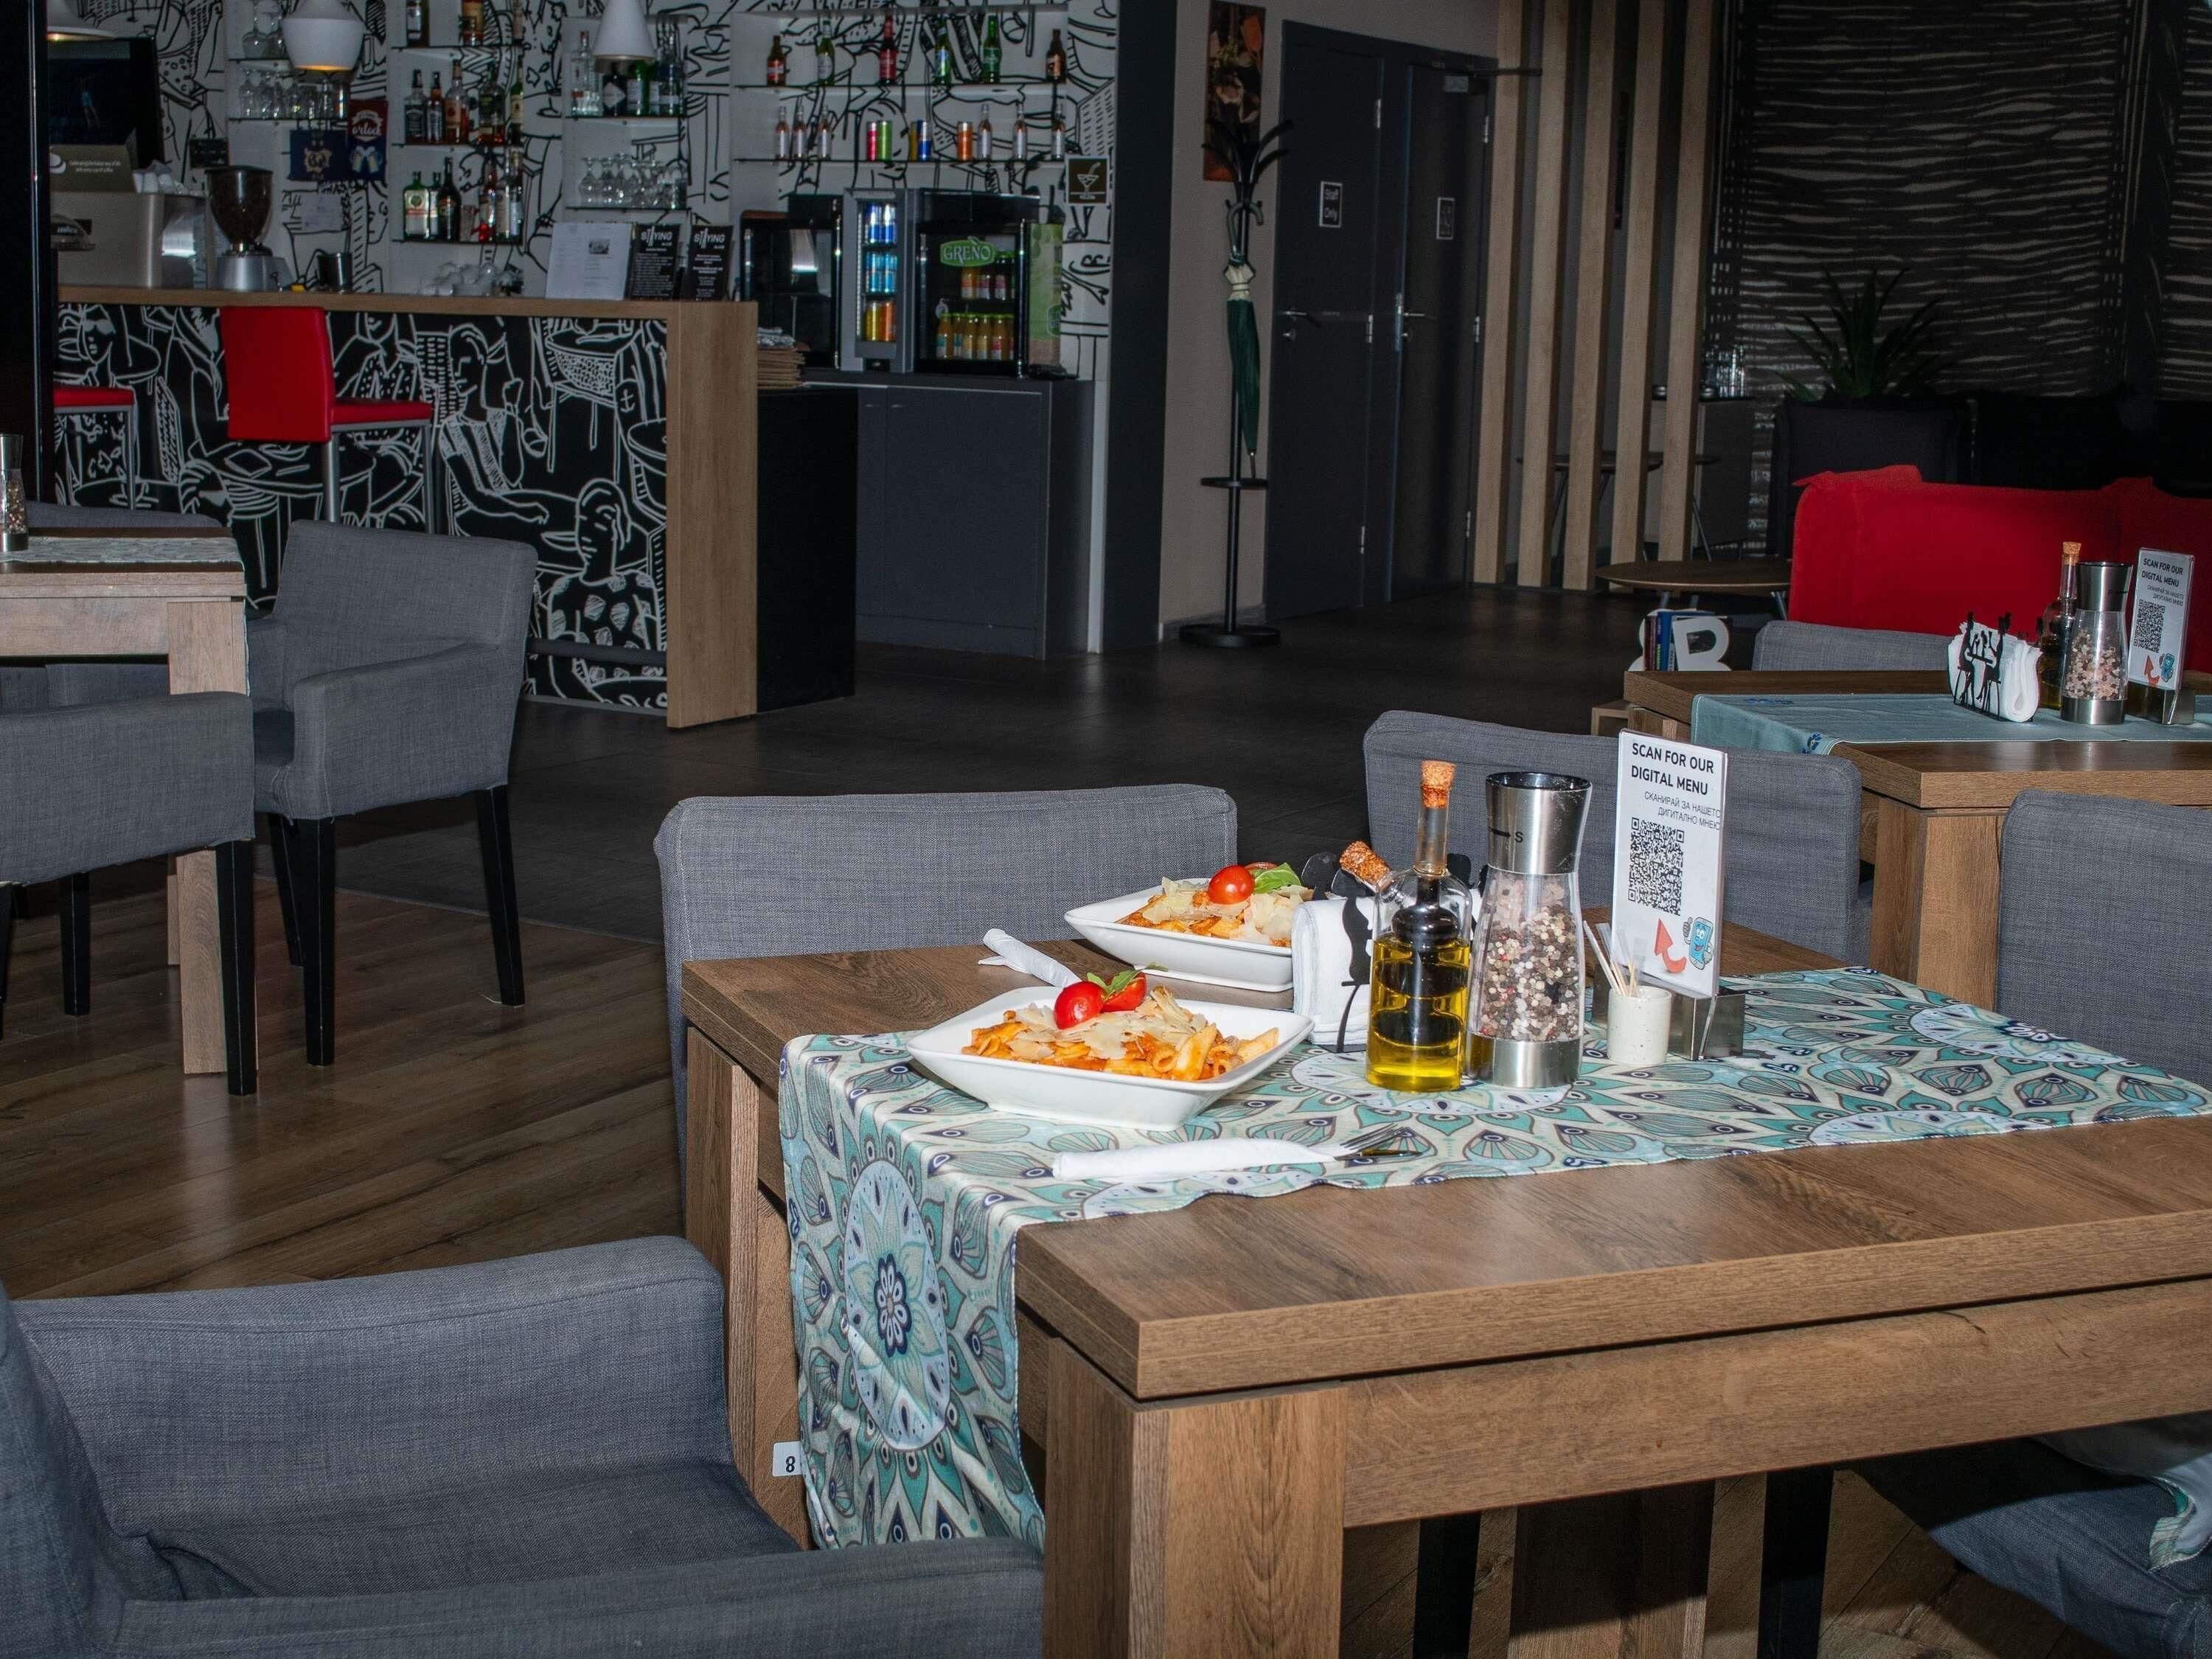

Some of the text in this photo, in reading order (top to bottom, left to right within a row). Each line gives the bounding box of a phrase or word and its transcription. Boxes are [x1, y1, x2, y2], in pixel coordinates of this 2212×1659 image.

[1324, 188, 1340, 200] Staff
[1324, 206, 1338, 220] Only
[943, 245, 991, 264] GRENO
[2142, 557, 2183, 575] SCAN FOR OUR
[2141, 571, 2180, 588] DIGITAL MENU
[1632, 742, 1714, 773] SCAN FOR OUR
[1631, 765, 1708, 796] DIGITAL MENU
[1644, 790, 1680, 807] СКАНИРАЙ
[1681, 800, 1690, 810] ЗА
[1658, 807, 1697, 824] ДИГИТАЛНО
[1512, 830, 1520, 841] S
[785, 1455, 796, 1473] 8
